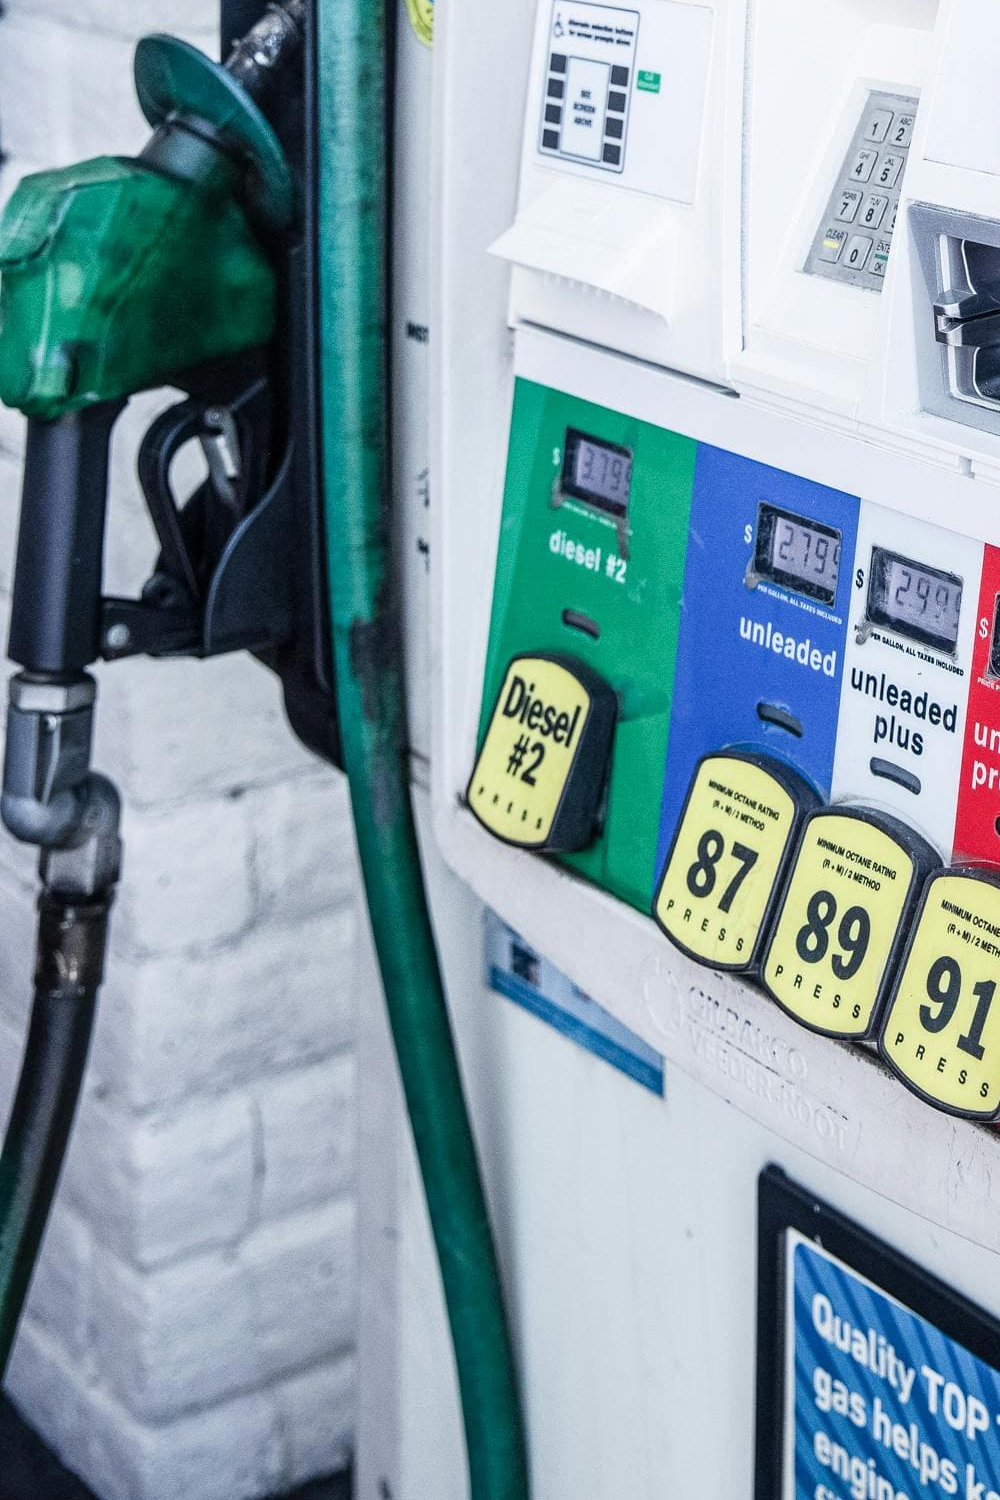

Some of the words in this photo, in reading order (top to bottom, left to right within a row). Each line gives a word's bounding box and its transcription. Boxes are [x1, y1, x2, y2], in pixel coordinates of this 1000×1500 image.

[872, 122, 879, 137] 1
[896, 128, 905, 142] 2
[900, 117, 912, 127] ABC
[855, 162, 863, 177] 4
[880, 168, 890, 182] 5
[840, 202, 849, 217] 7
[865, 208, 874, 223] 8
[825, 228, 844, 241] CLEAR
[849, 248, 858, 263] 0
[876, 241, 890, 255] ENTE
[550, 529, 601, 572] diesel
[605, 553, 627, 584] #2
[757, 584, 769, 593] PER
[790, 598, 800, 607] ALL
[800, 602, 816, 614] TAXES
[816, 609, 843, 625] INCLUDED
[740, 617, 837, 677] unleaded
[979, 618, 989, 639] $
[906, 646, 916, 657] ALL
[917, 652, 935, 664] TAXES
[936, 658, 964, 677] INCLUDED
[502, 676, 582, 748] Diesel
[851, 667, 958, 734] unleaded
[874, 713, 924, 756] plus
[506, 734, 547, 786] #2
[708, 779, 734, 799] MINIMUM
[733, 790, 757, 812] OCTANE
[757, 801, 780, 821] RATING
[740, 812, 765, 832] METHOD
[686, 829, 760, 914] 87
[816, 837, 846, 857] MINIMUM
[845, 849, 871, 869] OCTANE
[871, 861, 896, 880] RATING
[853, 872, 881, 891] METHOD
[796, 890, 871, 981] 89
[940, 899, 973, 922] MINIMUM
[973, 913, 1000, 938] OCTANE
[919, 955, 997, 1061] 91
[812, 1292, 916, 1405] Quality
[921, 1365, 990, 1441] TOP
[813, 1366, 867, 1428] gas
[873, 1397, 958, 1494] helps
[813, 1431, 904, 1500] engin
